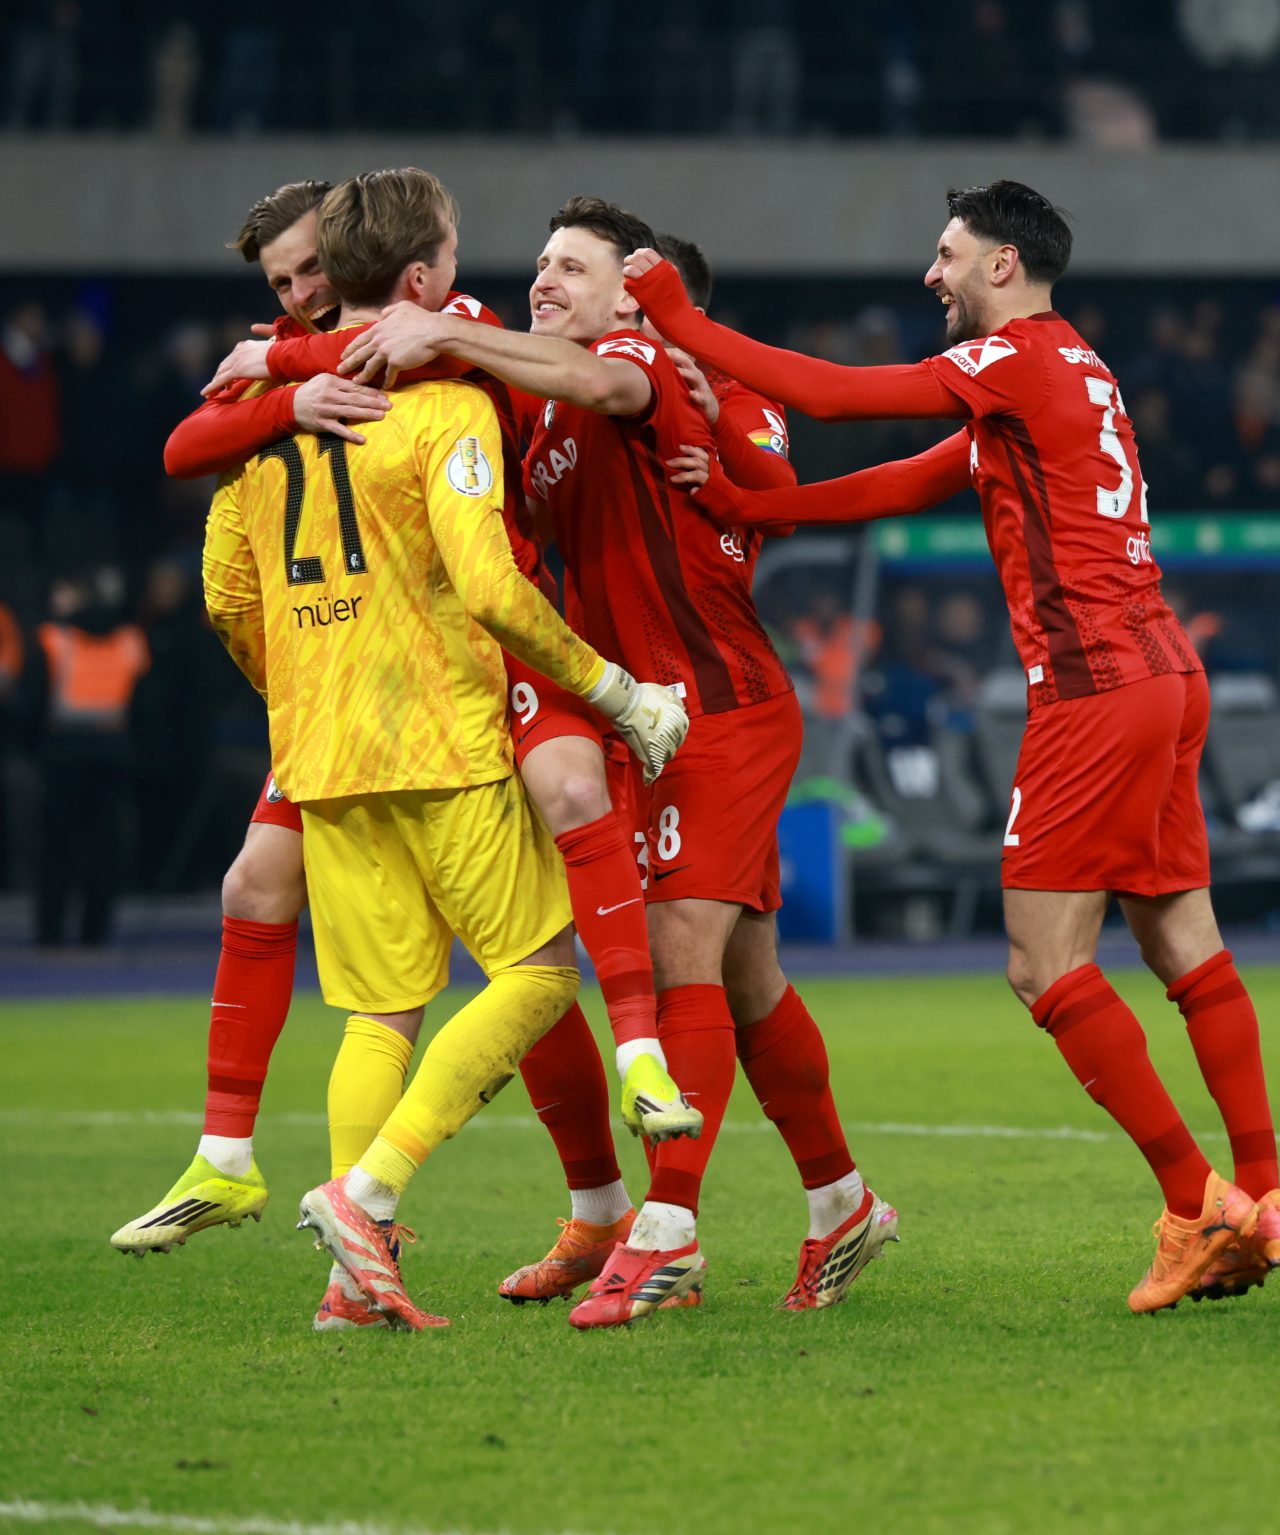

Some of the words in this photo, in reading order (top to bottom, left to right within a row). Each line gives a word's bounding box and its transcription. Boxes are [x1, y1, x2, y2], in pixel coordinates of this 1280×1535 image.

[258, 434, 369, 588] 21
[511, 681, 539, 726] 9
[657, 805, 682, 861] 8
